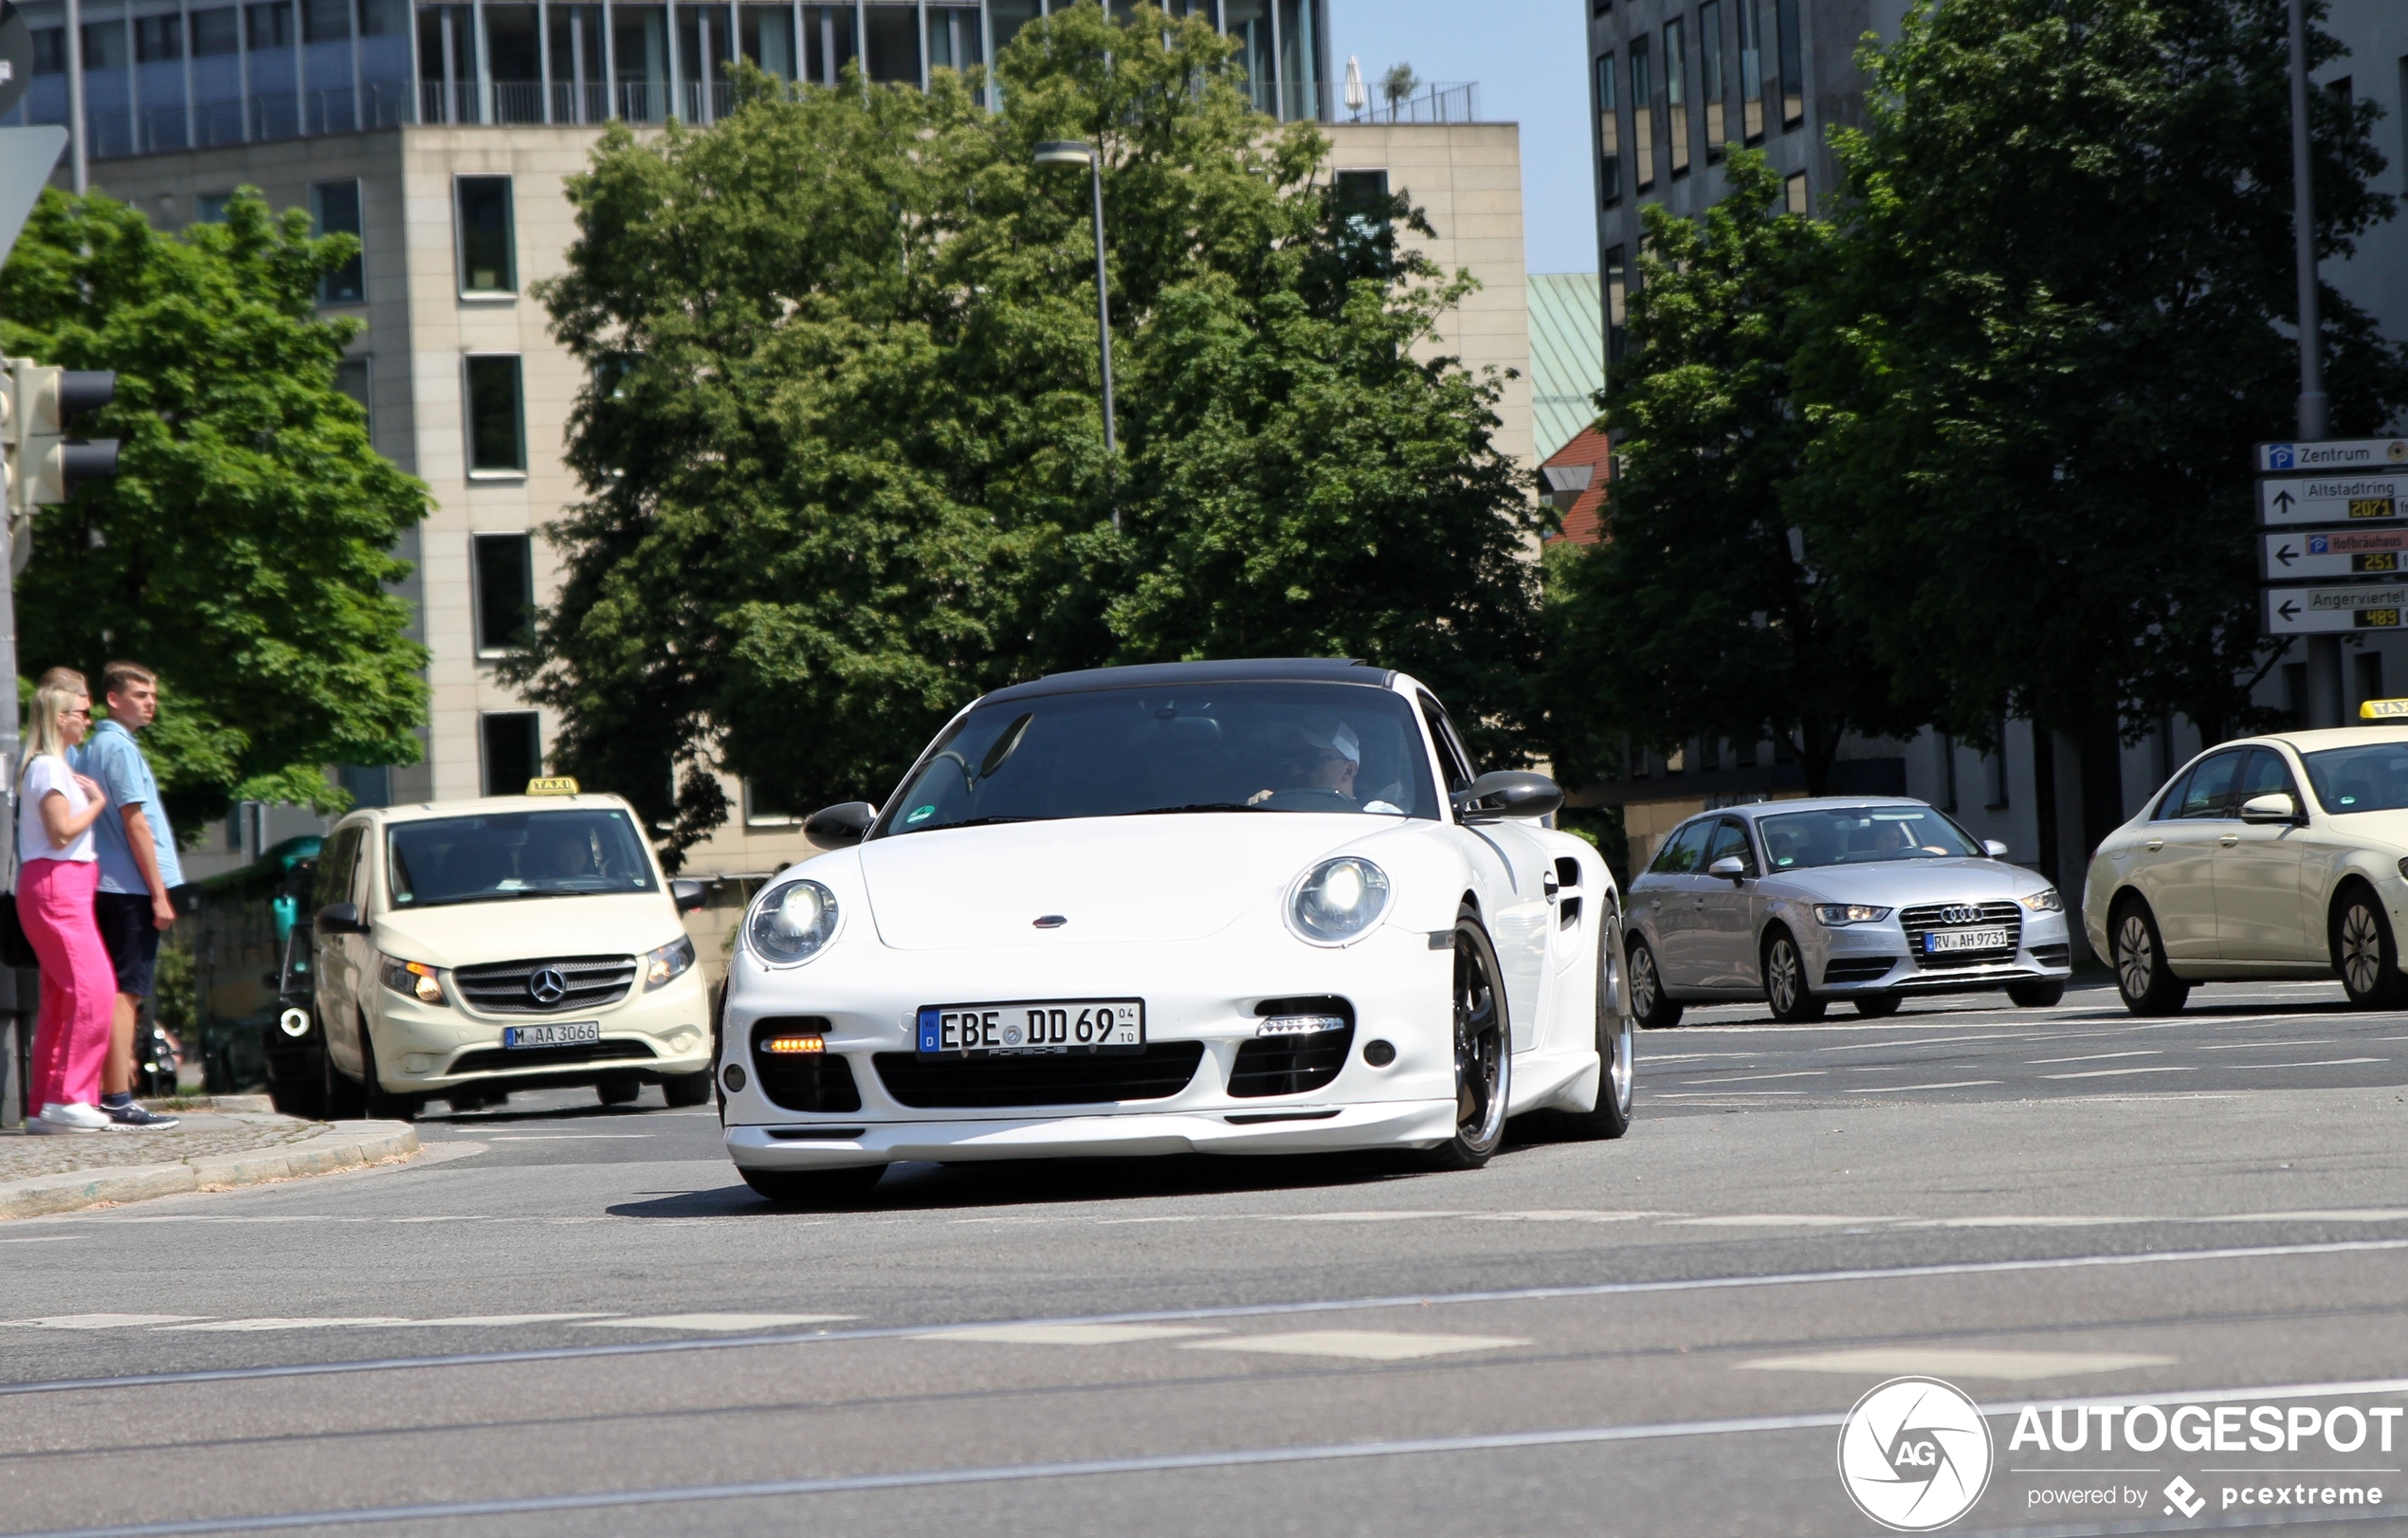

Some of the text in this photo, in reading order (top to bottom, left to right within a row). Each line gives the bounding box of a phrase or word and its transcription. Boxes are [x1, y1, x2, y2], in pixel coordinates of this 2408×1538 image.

[2301, 449, 2370, 464] Zentrum
[2308, 481, 2395, 497] Altstadtring
[2351, 500, 2393, 517] 2071
[2333, 535, 2402, 550] Hofbräuhaus
[2364, 554, 2396, 570] 251
[2313, 591, 2406, 608] Angerviertel
[2366, 610, 2398, 626] 489
[535, 779, 570, 789] TAXI
[1934, 935, 1949, 949] RV
[1960, 934, 1975, 947] AH
[1977, 932, 2006, 945] 9731
[1119, 1008, 1134, 1018] 04
[515, 1029, 525, 1044] M
[536, 1027, 555, 1043] AA
[557, 1025, 595, 1041] 3066
[926, 1008, 1114, 1048] D EBE DD 69
[1121, 1032, 1134, 1042] 10
[989, 1046, 1067, 1056] PORSCHE
